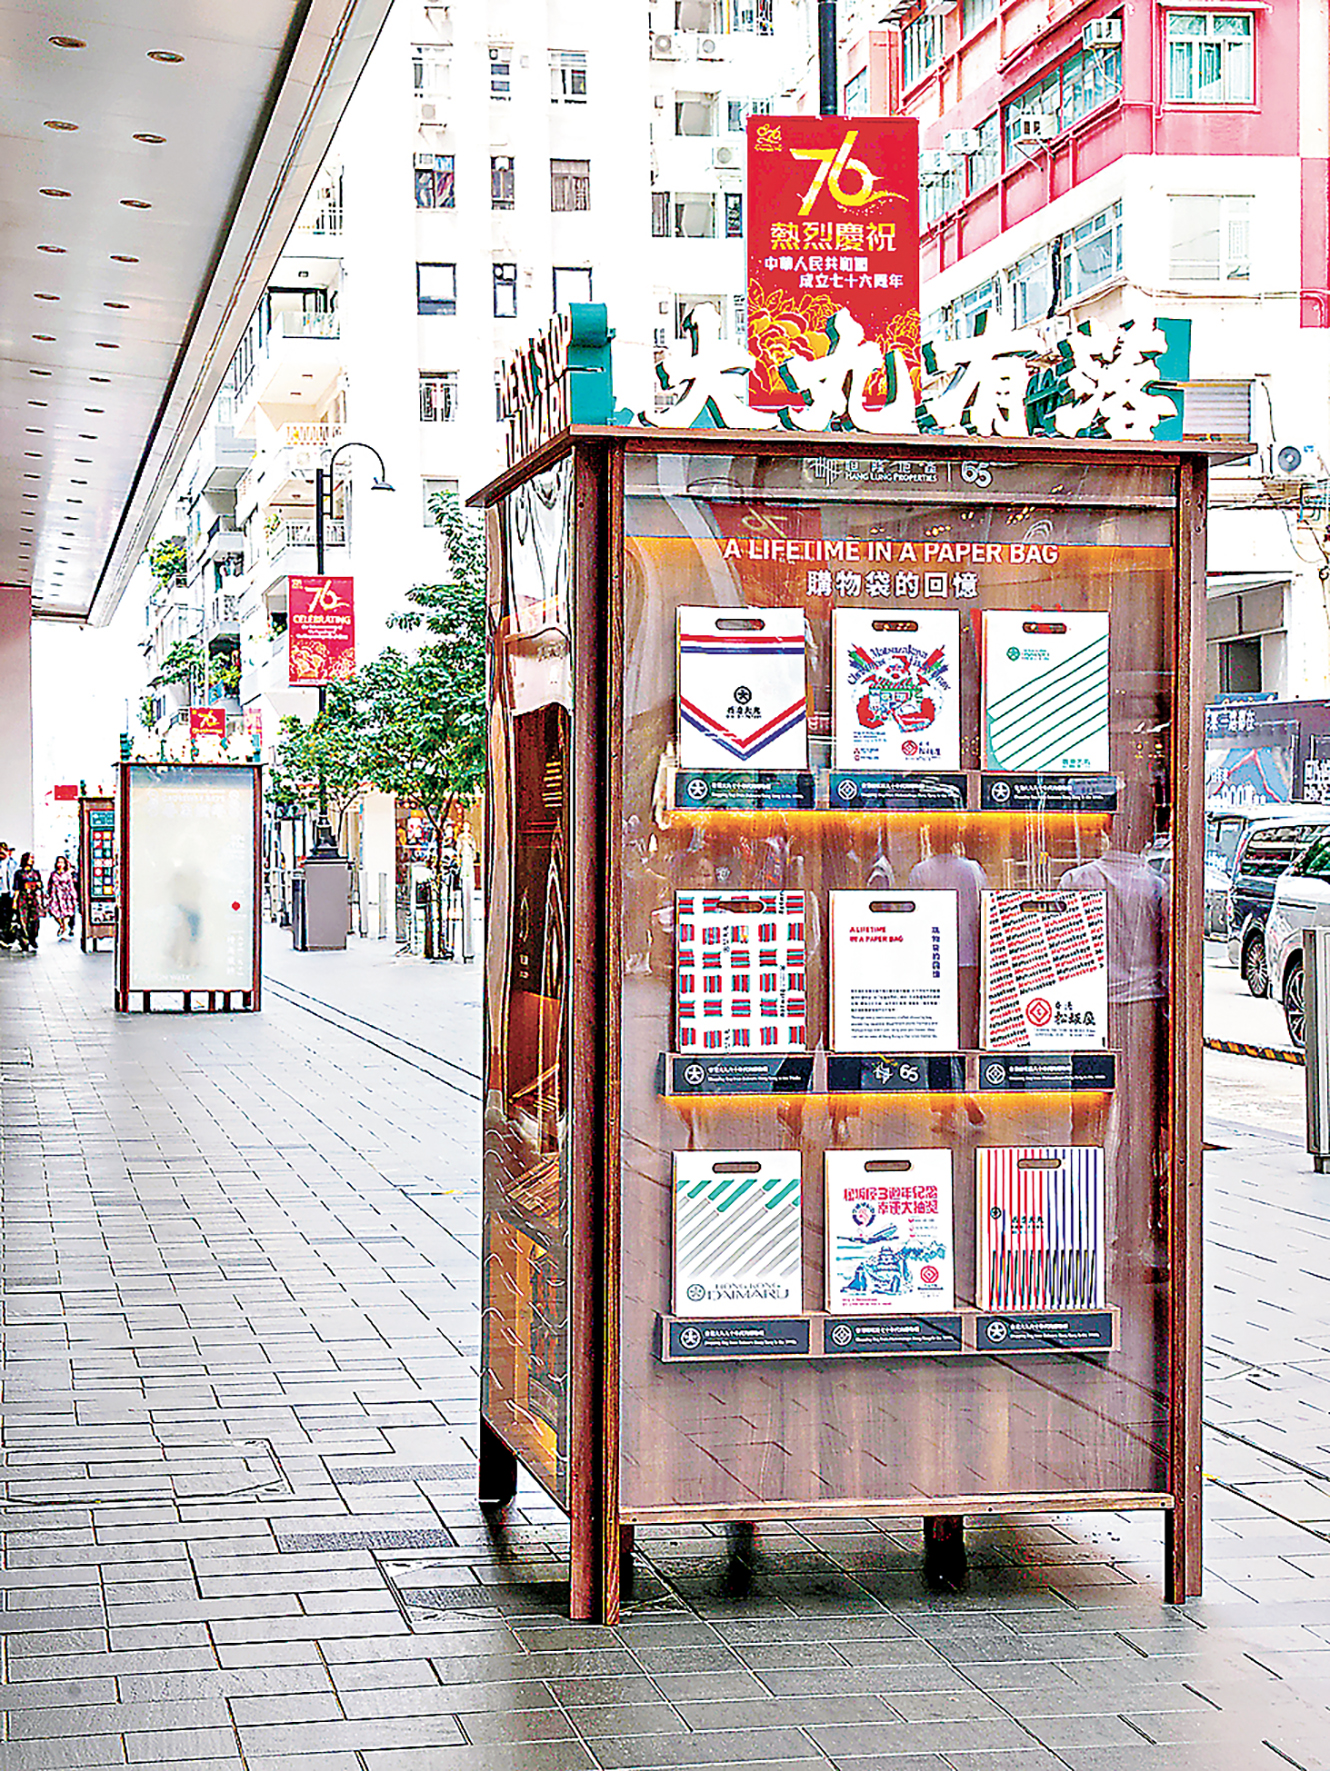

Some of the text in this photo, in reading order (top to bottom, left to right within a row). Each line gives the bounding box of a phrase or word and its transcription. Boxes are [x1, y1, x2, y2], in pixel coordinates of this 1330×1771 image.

[789, 131, 890, 216] 76
[771, 222, 896, 251] 熱烈慶祝
[764, 255, 869, 272] 中華人民共和國
[637, 301, 1178, 441] 大丸有落
[960, 460, 993, 488] 65
[723, 540, 1058, 565] A LIFETIME IN A PAPER BAG
[304, 579, 348, 612] 76
[806, 569, 979, 598] 購物袋的回憶
[899, 1063, 920, 1083] 65
[707, 1288, 790, 1301] DAIMARU
